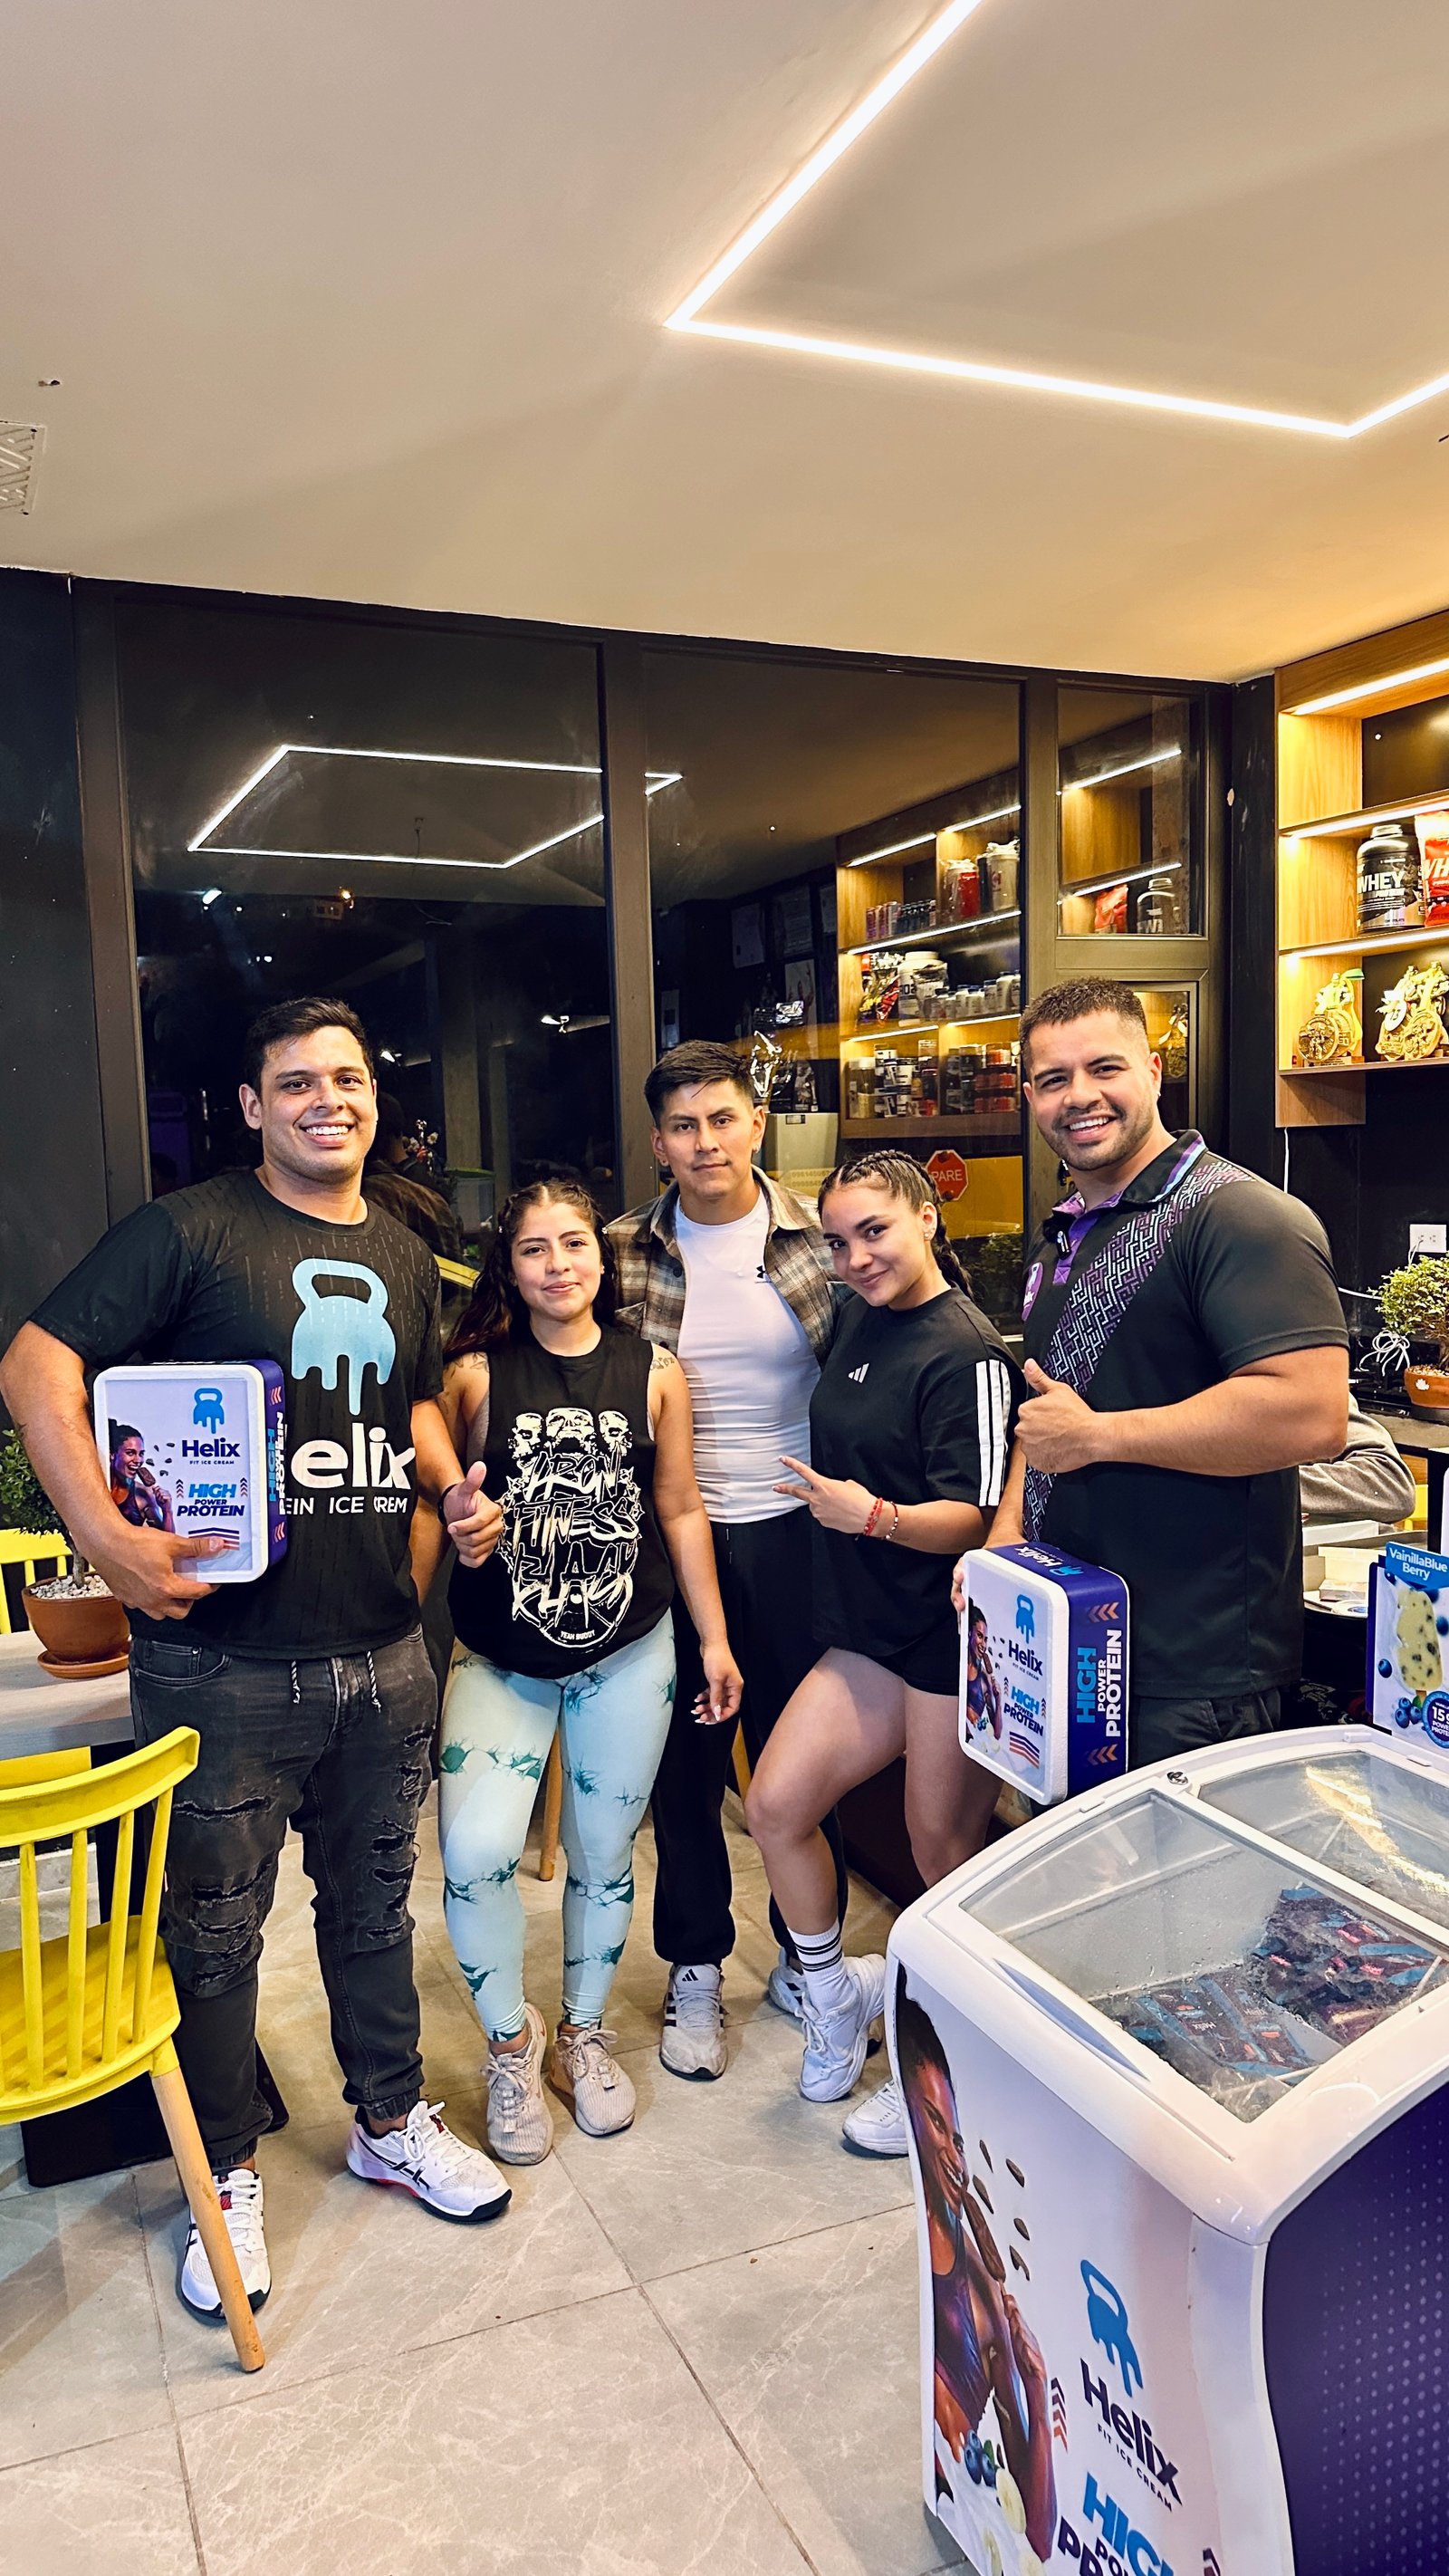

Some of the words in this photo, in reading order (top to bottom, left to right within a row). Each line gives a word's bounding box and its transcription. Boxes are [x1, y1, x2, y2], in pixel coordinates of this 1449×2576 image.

[1357, 870, 1406, 894] WHEY
[931, 1169, 963, 1182] PARE
[181, 1437, 241, 1458] Helix
[267, 1428, 276, 1502] HIGH
[276, 1411, 286, 1515] PROTEIN
[290, 1422, 417, 1490] elix
[524, 1441, 622, 1504] IRON
[188, 1483, 237, 1498] HIGH
[329, 1496, 364, 1514] ICE
[177, 1504, 245, 1517] PROTEIN
[513, 1496, 639, 1556] FITNESS
[1014, 1546, 1063, 1567] Helix
[1389, 1547, 1448, 1572] VainillaBlue
[1403, 1562, 1431, 1581] Berry
[1008, 1639, 1043, 1677] Helix
[1077, 1647, 1097, 1724] HIGH
[1098, 1659, 1107, 1712] POWER
[1106, 1629, 1122, 1737] PROTEIN
[1011, 1686, 1040, 1716] HIGH
[1014, 1702, 1034, 1719] POWER
[1003, 1702, 1044, 1737] PROTEIN
[1080, 2358, 1184, 2506] Helix
[1098, 2423, 1112, 2445] FIT
[1116, 2444, 1132, 2468] ICE
[1136, 2466, 1173, 2514] CREAM
